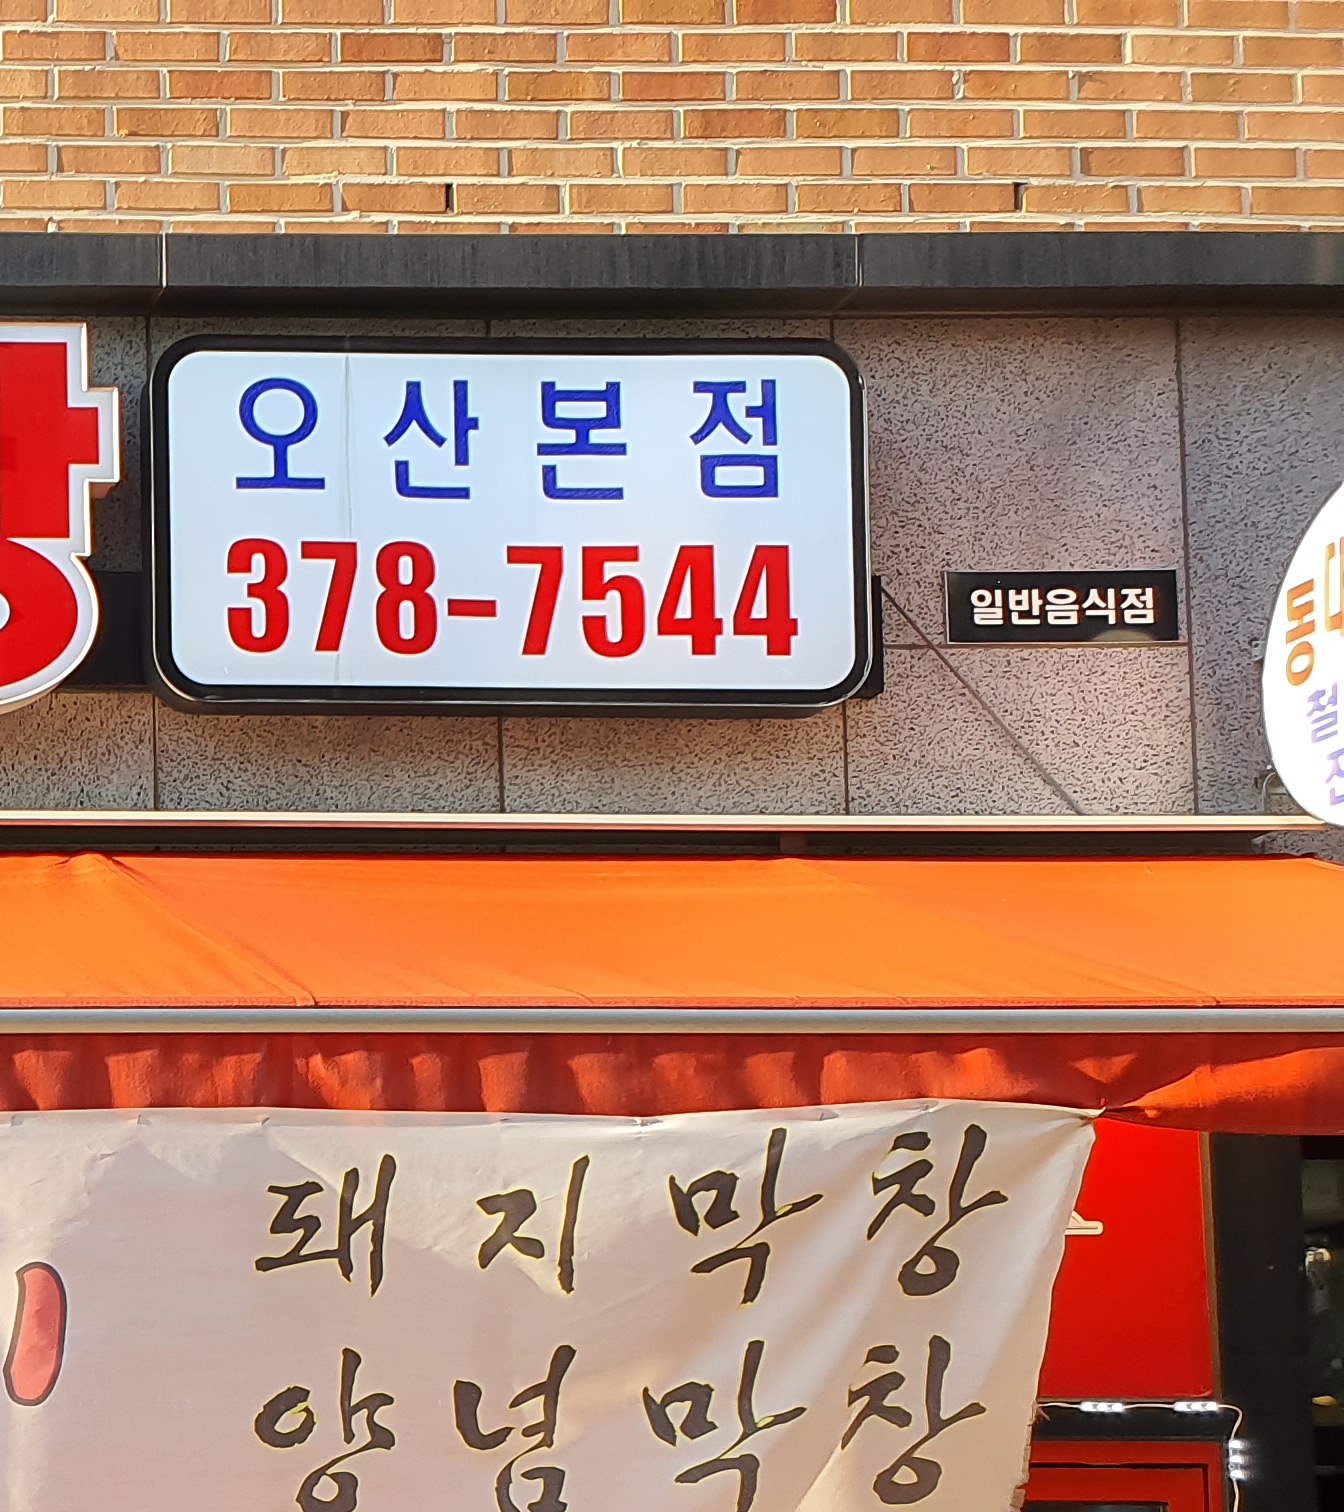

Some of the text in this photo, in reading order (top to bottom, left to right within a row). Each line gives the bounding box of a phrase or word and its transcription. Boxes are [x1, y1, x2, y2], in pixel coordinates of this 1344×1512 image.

[234, 375, 782, 502] 오산본점
[224, 537, 800, 660] 378-7544
[967, 583, 1157, 630] 일반음식점
[253, 1123, 1010, 1308] 돼지막창
